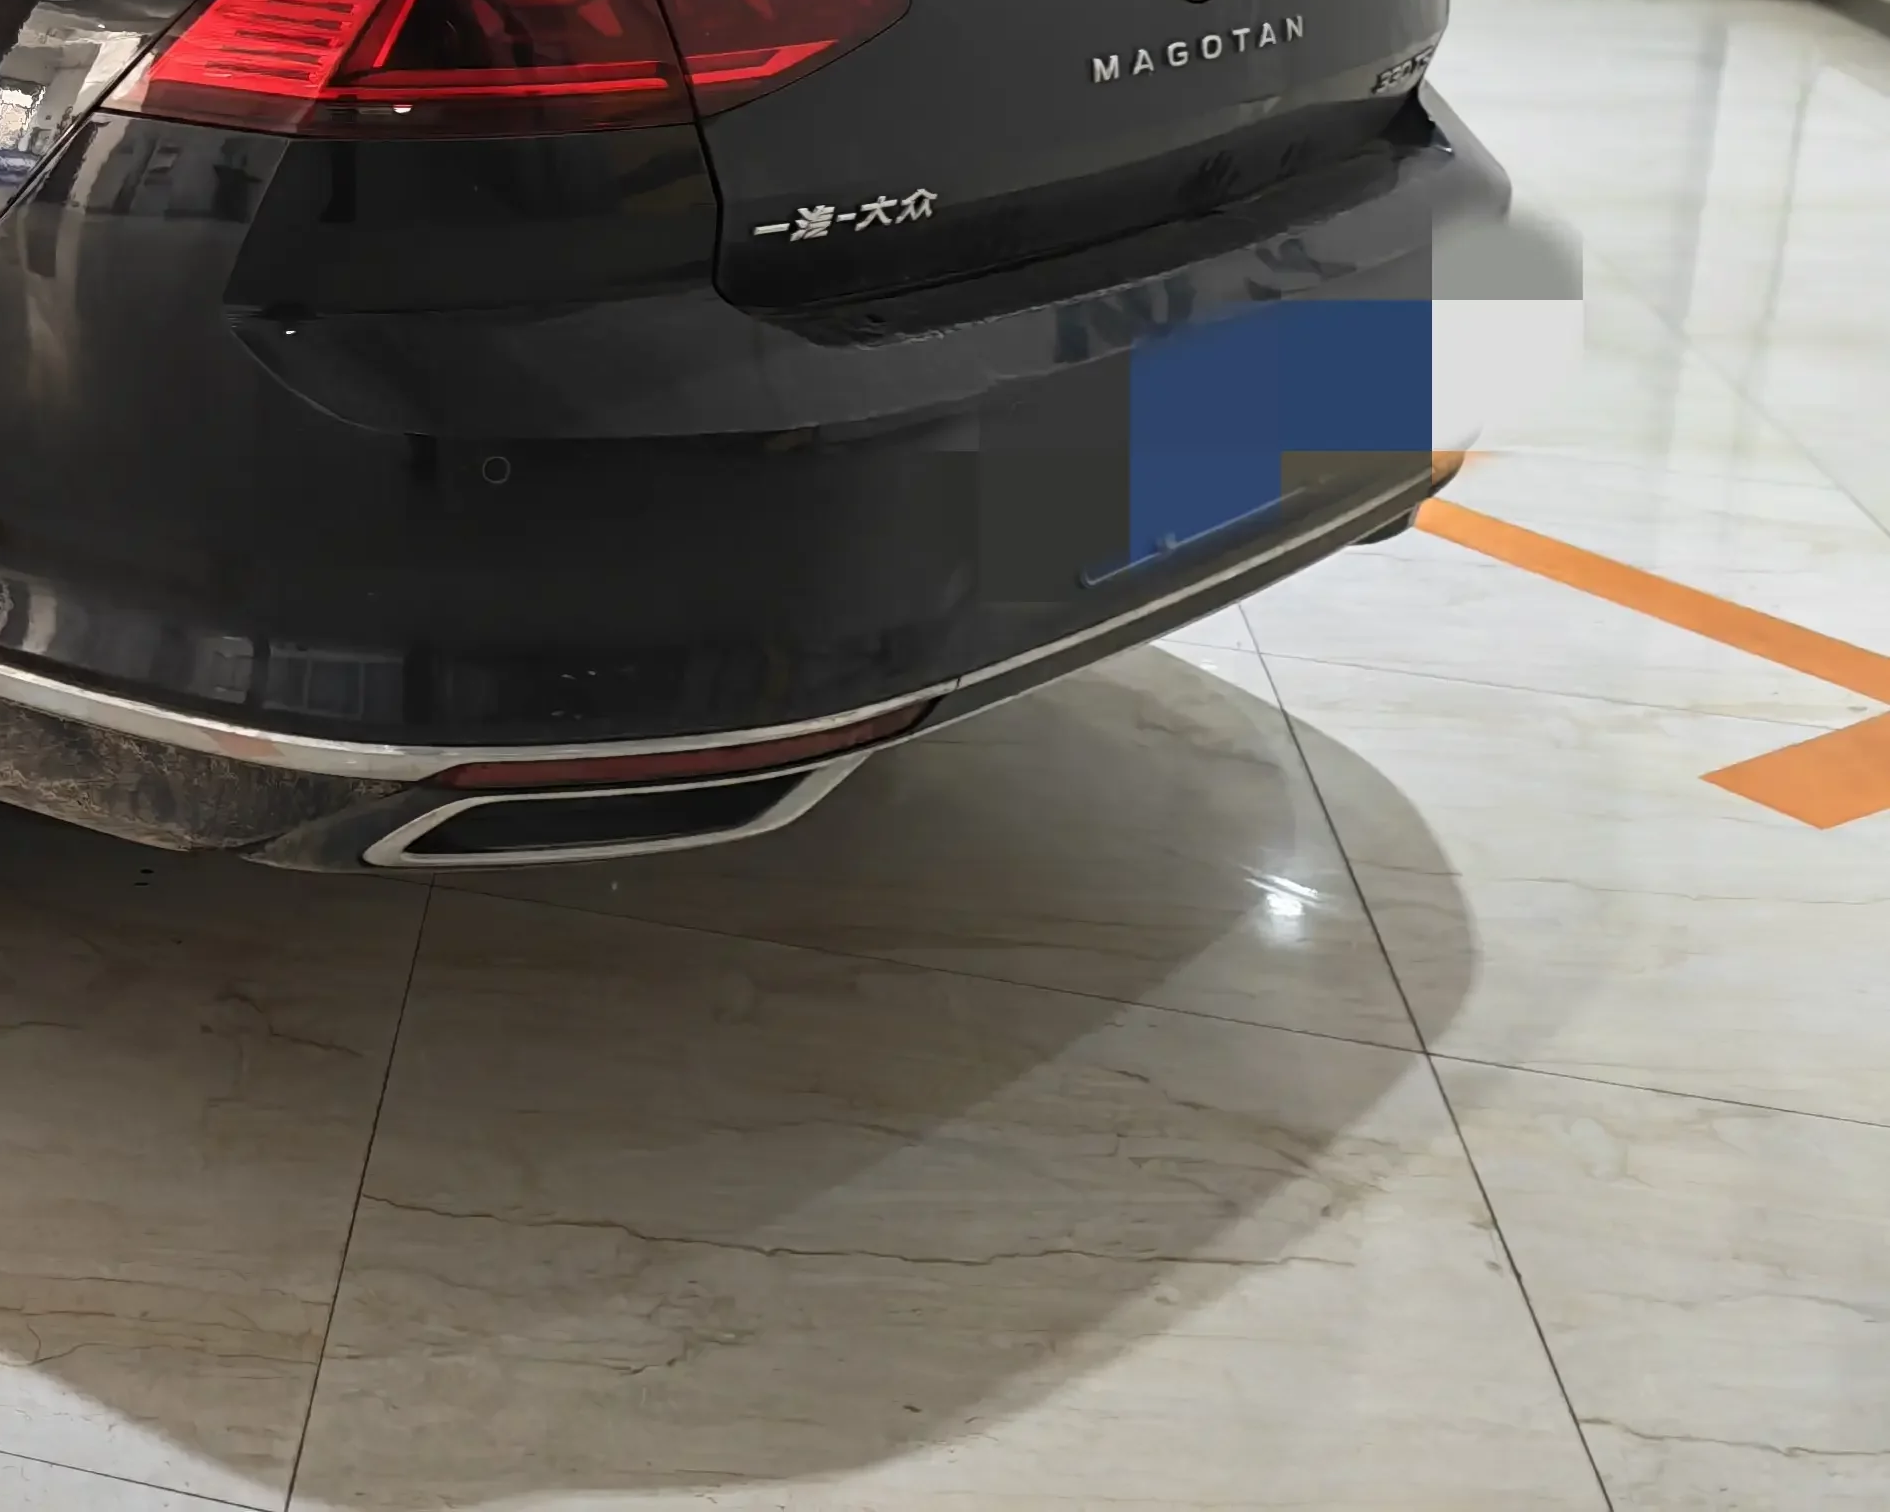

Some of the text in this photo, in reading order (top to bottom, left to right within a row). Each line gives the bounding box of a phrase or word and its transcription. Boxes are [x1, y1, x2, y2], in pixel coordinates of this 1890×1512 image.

[1089, 14, 1306, 85] MAGOTAN
[753, 187, 938, 242] 一汽-大众
